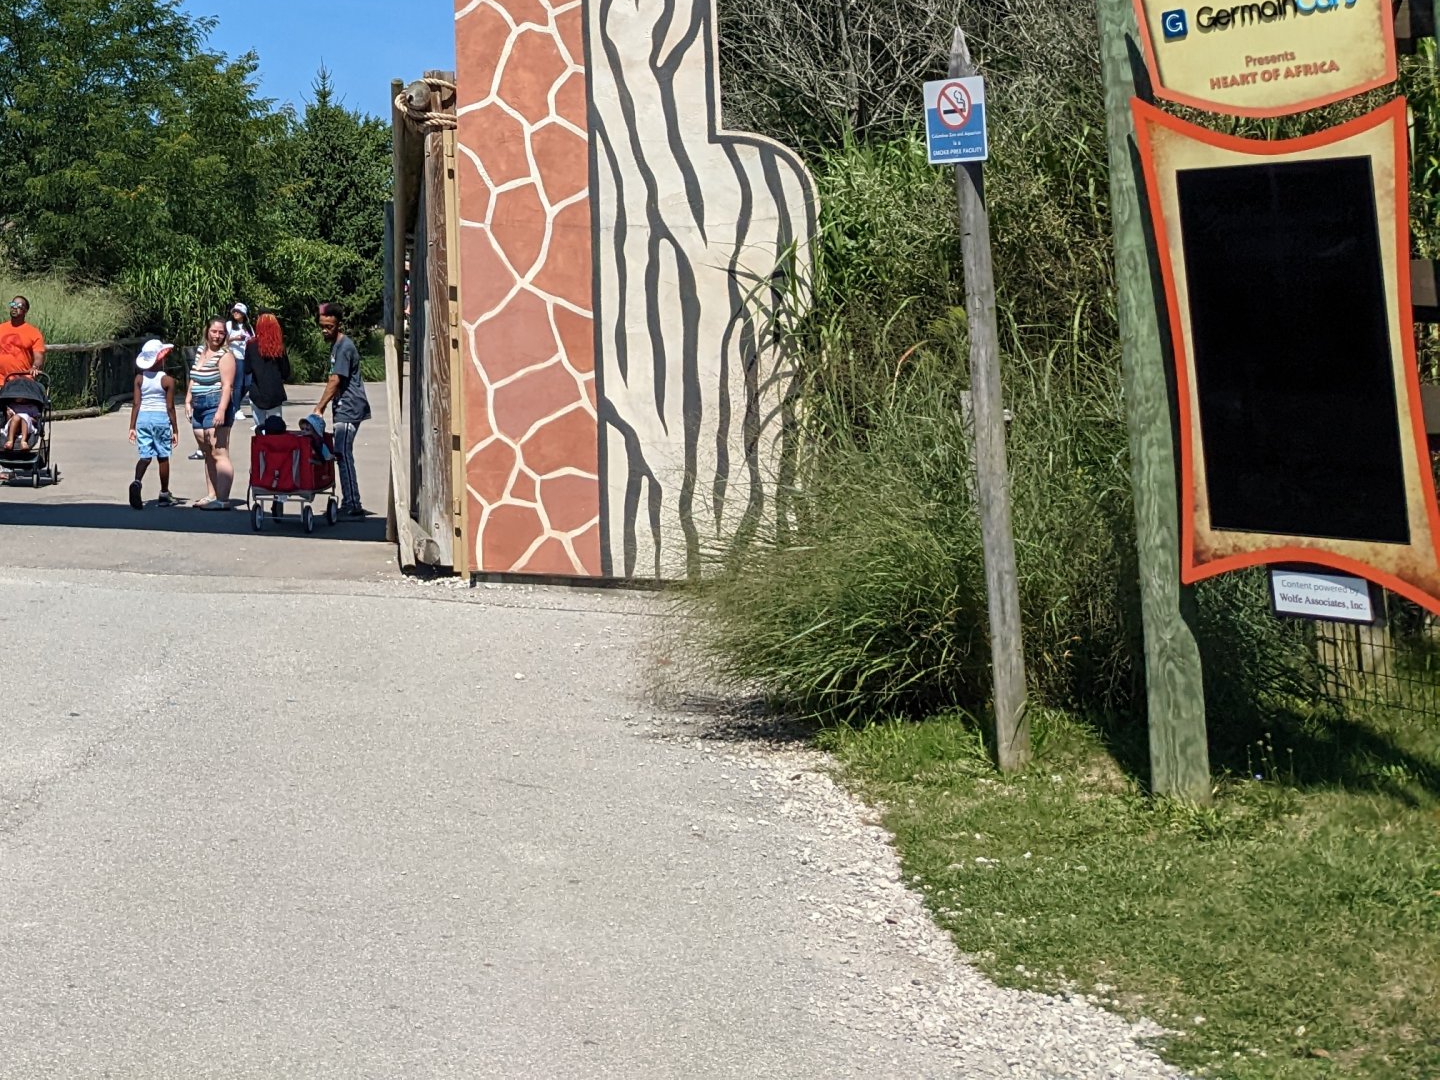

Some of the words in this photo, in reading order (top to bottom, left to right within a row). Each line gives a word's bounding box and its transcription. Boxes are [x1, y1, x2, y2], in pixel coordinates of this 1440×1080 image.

[1245, 50, 1296, 67] Presents
[1210, 71, 1258, 90] HEART
[1260, 68, 1280, 83] OF
[1284, 60, 1340, 80] AFRICA
[1281, 579, 1312, 590] Content
[1314, 584, 1347, 594] powered
[1349, 587, 1359, 597] by
[1280, 592, 1303, 604] Wolfe
[1304, 596, 1349, 610] Associates,
[1351, 600, 1366, 610] Inc.
